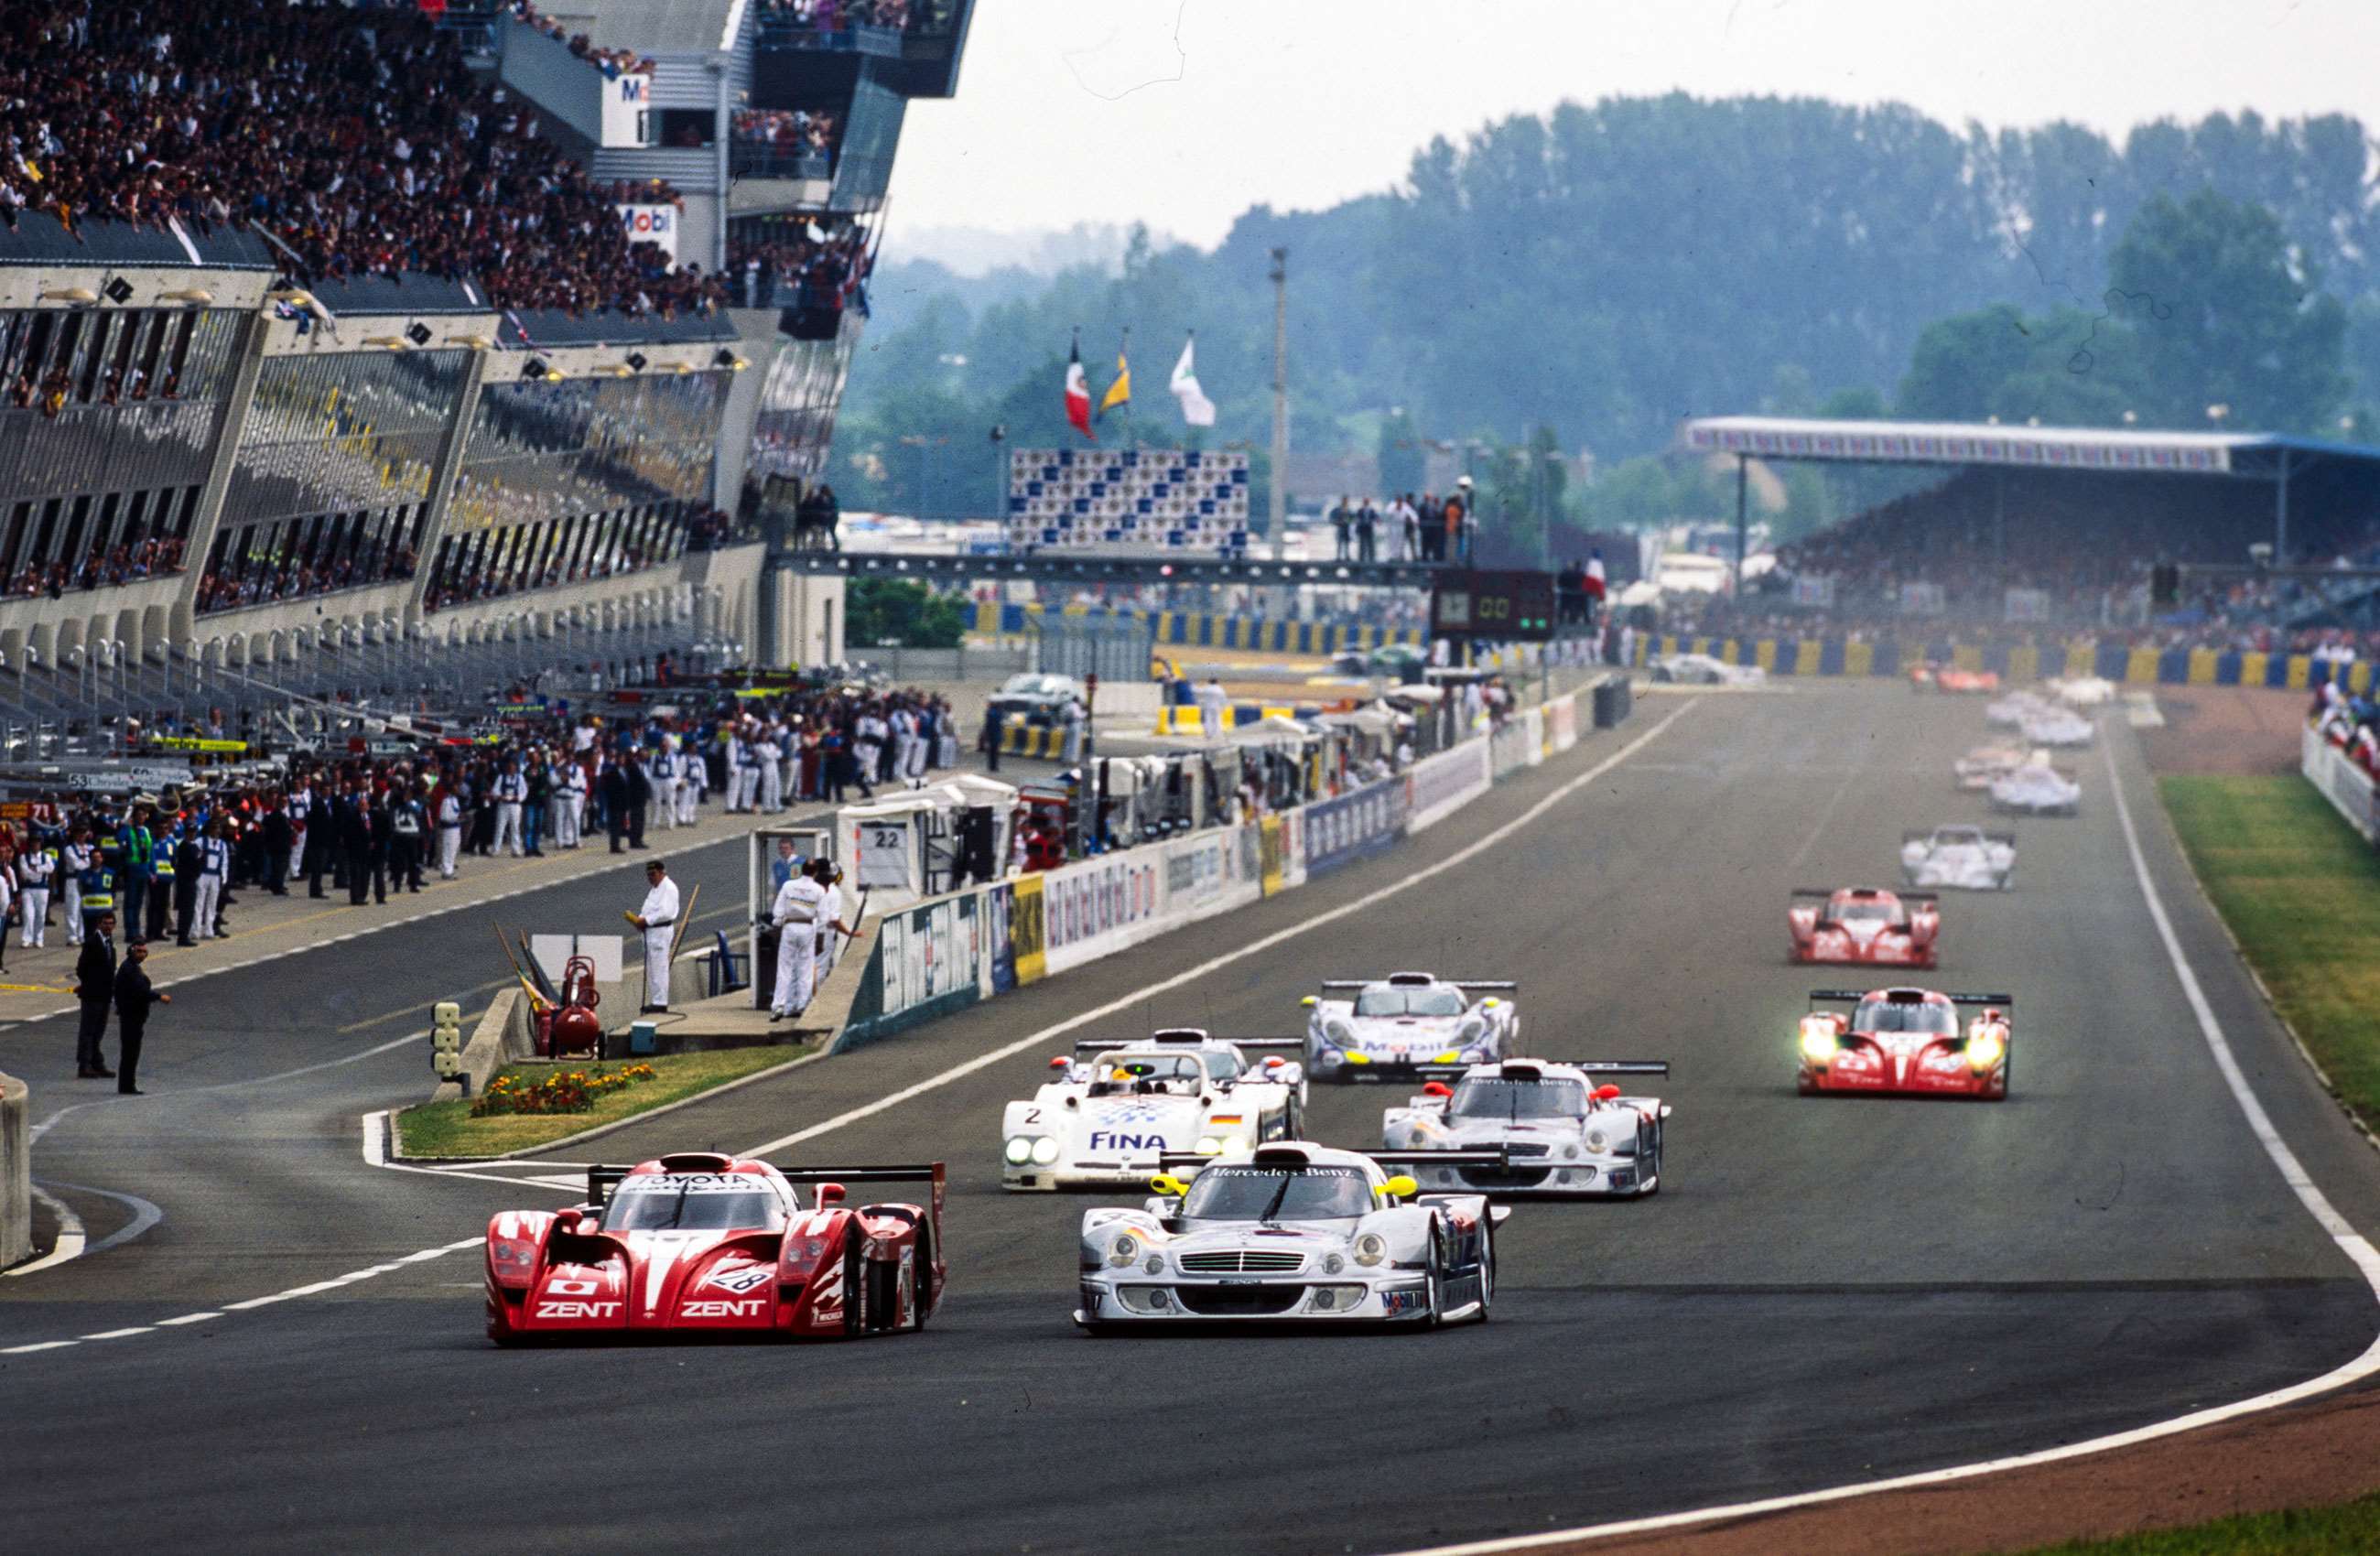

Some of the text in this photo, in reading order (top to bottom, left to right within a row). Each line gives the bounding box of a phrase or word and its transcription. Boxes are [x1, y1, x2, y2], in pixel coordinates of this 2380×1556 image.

[70, 774, 88, 787] 53
[875, 829, 899, 848] 22
[1024, 1108, 1042, 1125] 2
[1089, 1130, 1167, 1151] FINA
[637, 1173, 752, 1185] TOYOTA
[1207, 1167, 1355, 1178] Mercedes-Benz
[711, 1270, 768, 1291] 28
[535, 1301, 622, 1319] ZENT
[680, 1299, 767, 1318] ZENT
